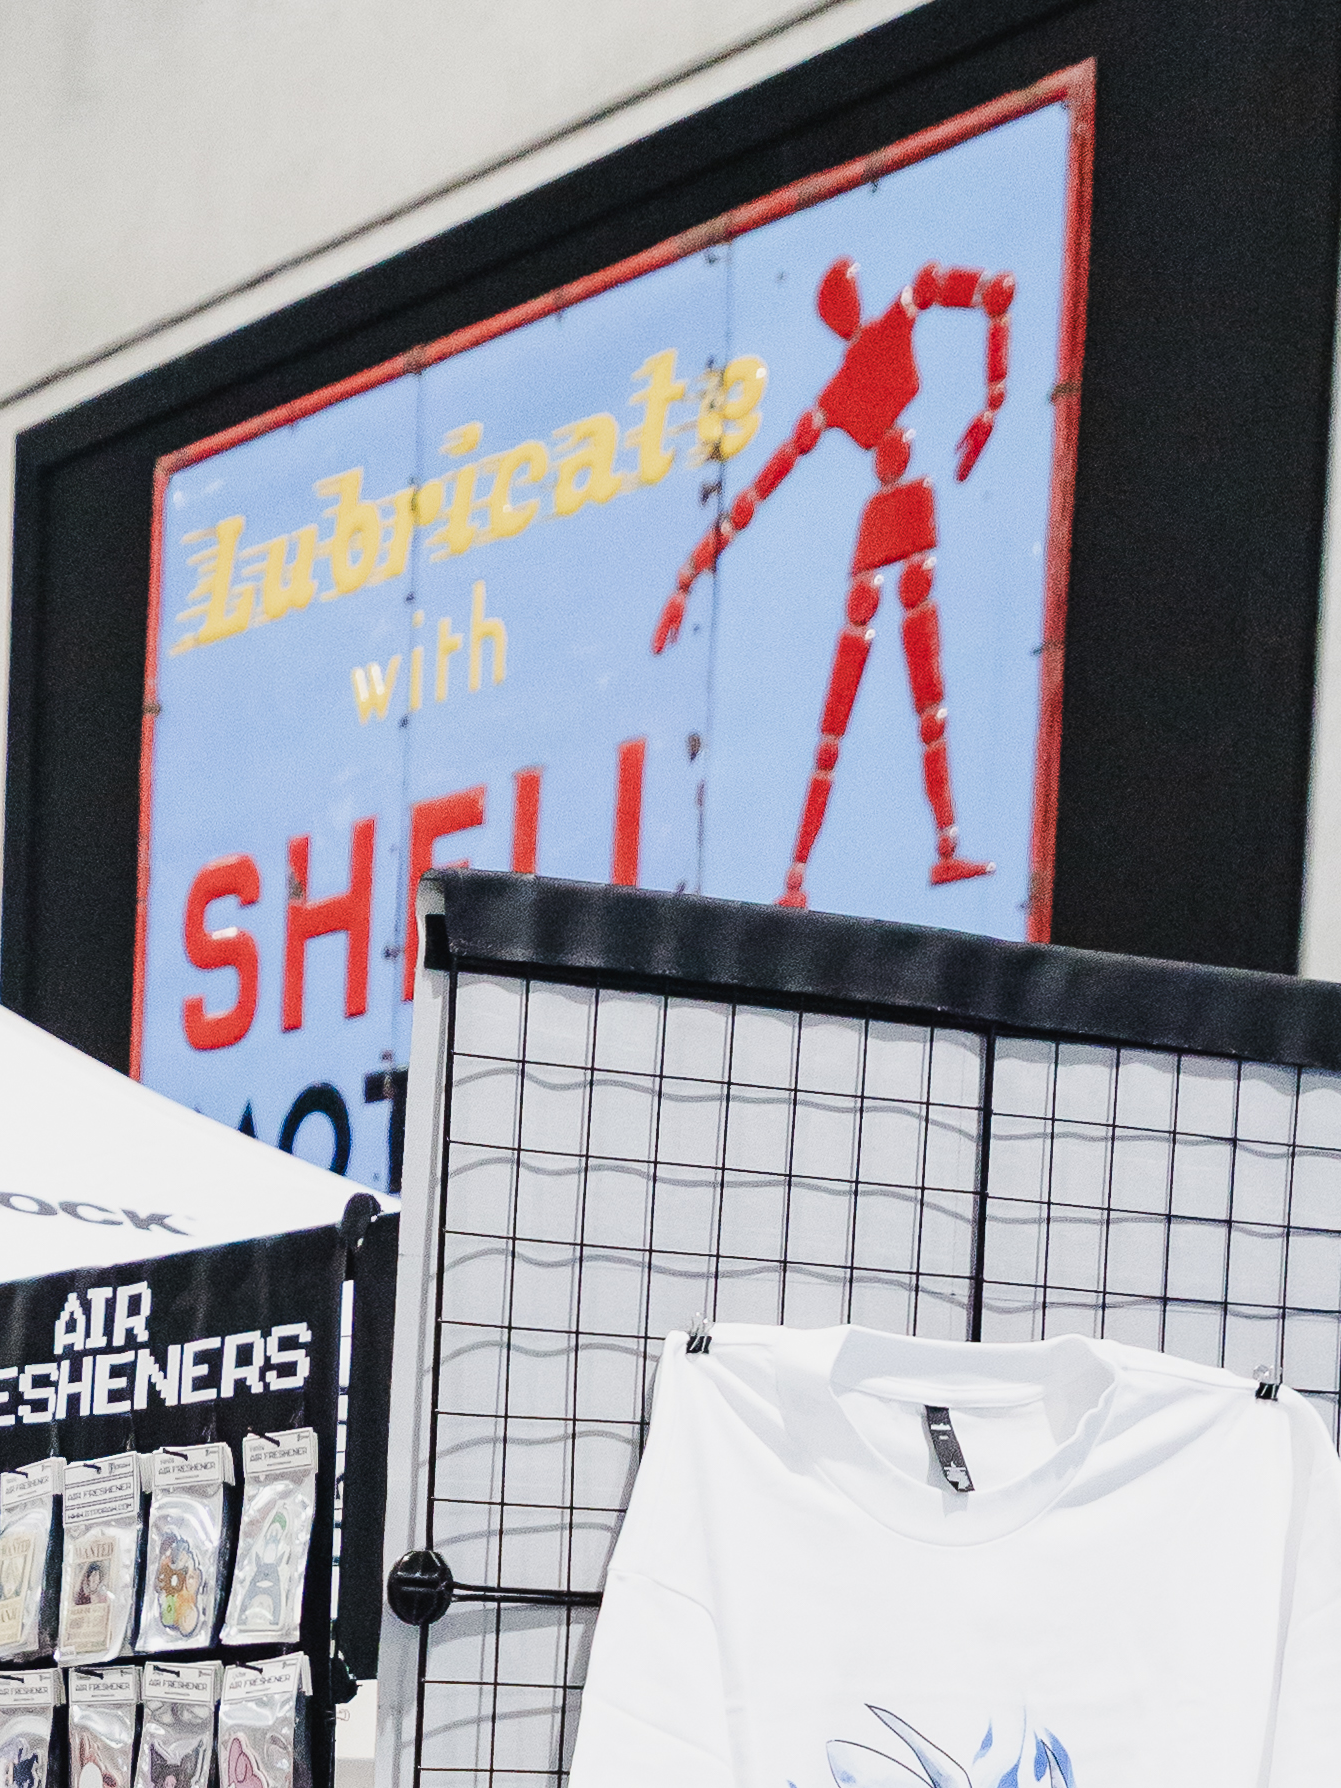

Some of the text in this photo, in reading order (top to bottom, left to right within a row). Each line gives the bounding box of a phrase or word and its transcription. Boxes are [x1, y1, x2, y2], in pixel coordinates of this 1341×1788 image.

[173, 348, 769, 658] Lubricate
[351, 581, 507, 724] with
[53, 1280, 153, 1357] AIR
